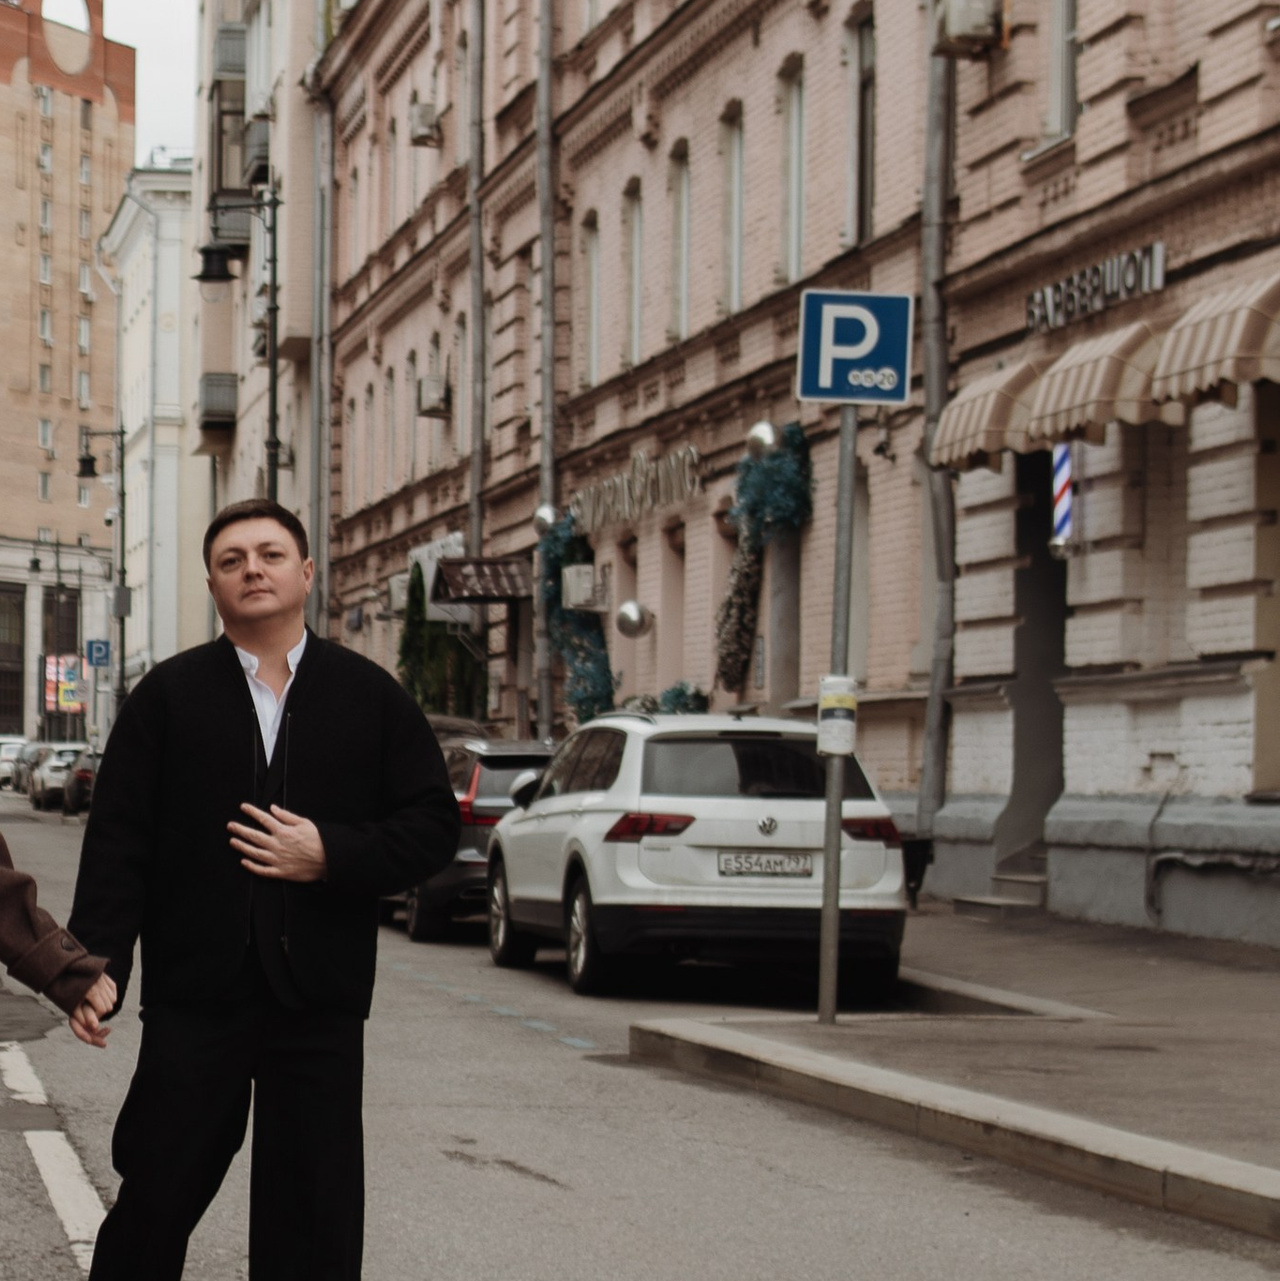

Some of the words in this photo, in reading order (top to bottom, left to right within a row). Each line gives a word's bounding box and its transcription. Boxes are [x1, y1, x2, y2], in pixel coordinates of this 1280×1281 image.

[1027, 241, 1165, 332] БАРБЕРШОП
[818, 303, 880, 389] P
[880, 372, 895, 386] 20
